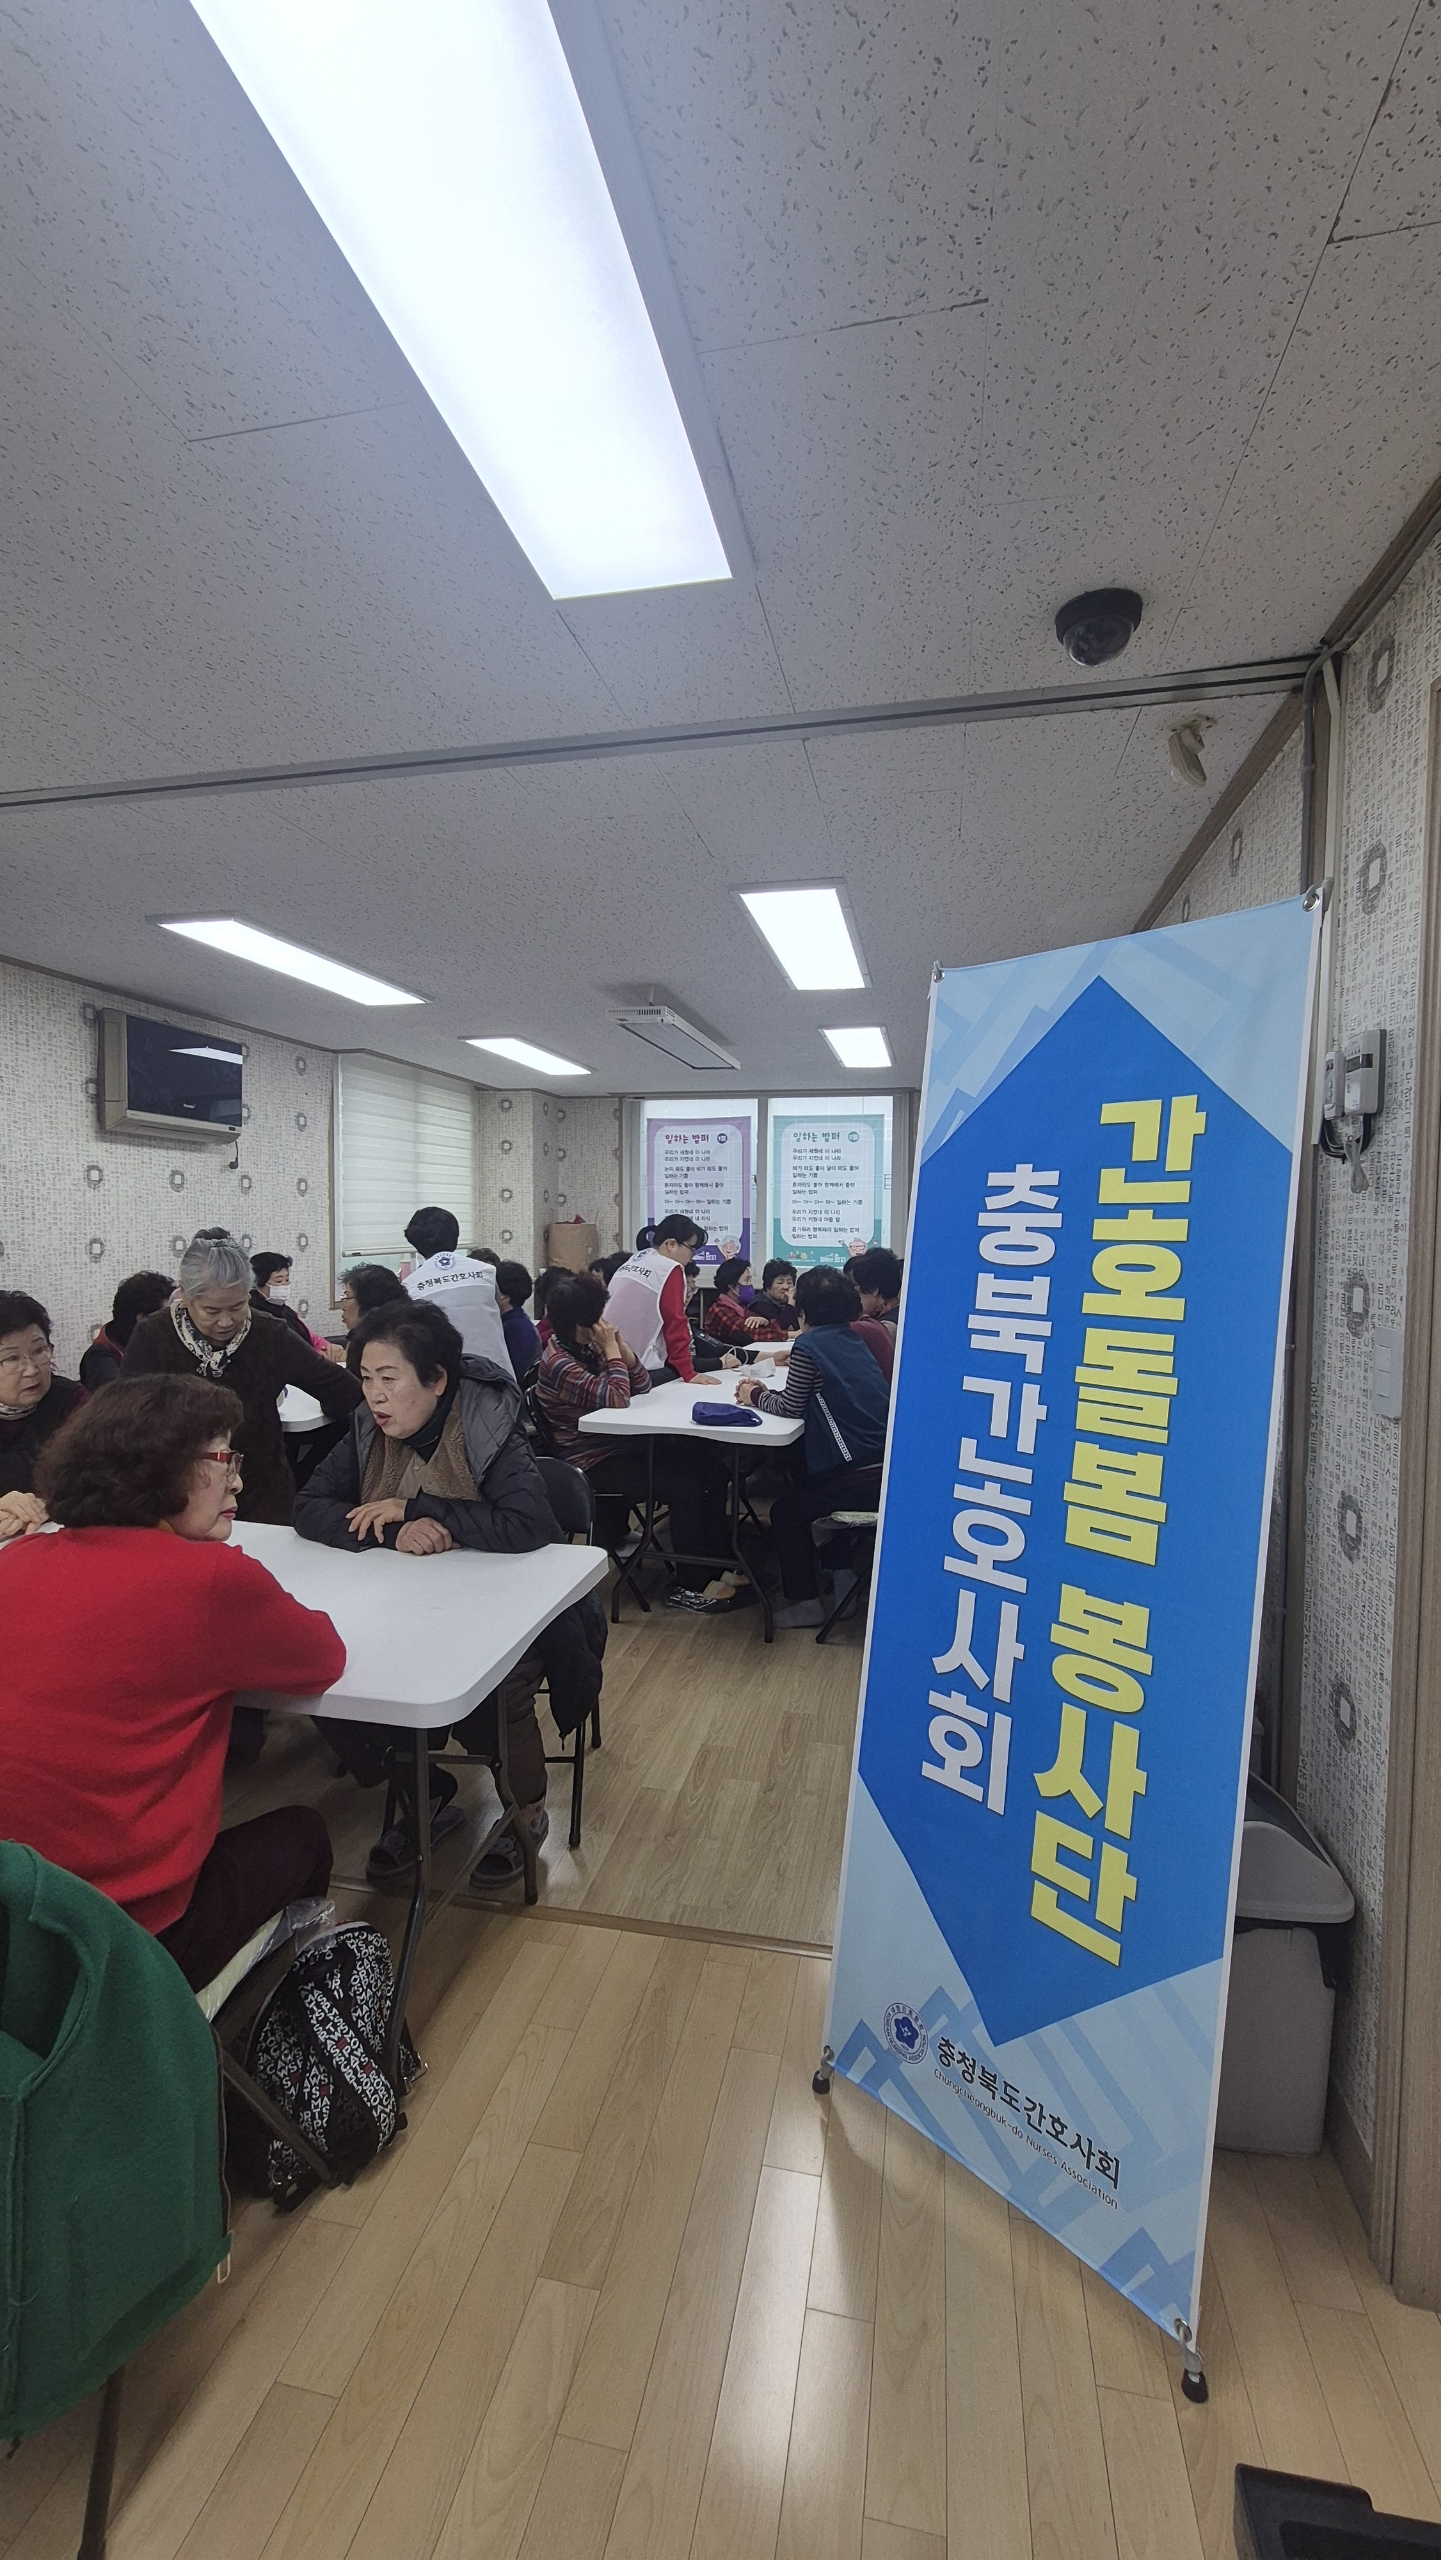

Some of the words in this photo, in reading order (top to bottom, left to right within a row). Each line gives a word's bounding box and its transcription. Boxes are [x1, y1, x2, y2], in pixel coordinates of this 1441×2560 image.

[665, 1134, 689, 1144] 일하는
[692, 1134, 709, 1144] 밥퍼
[793, 1132, 818, 1142] 일하는
[822, 1132, 840, 1142] 밥퍼
[417, 1271, 484, 1291] 충청북도간호사회
[1064, 1096, 1206, 1566] 간호돌봄
[922, 1163, 1063, 1816] 충북간호사회
[1031, 1585, 1152, 1966] 봉사단
[933, 2068, 1024, 2140] Chungcheongbuk-do
[1026, 2134, 1058, 2165] Nurses
[1060, 2160, 1119, 2210] Association
[936, 2035, 1121, 2190] 충청북도간호사회
